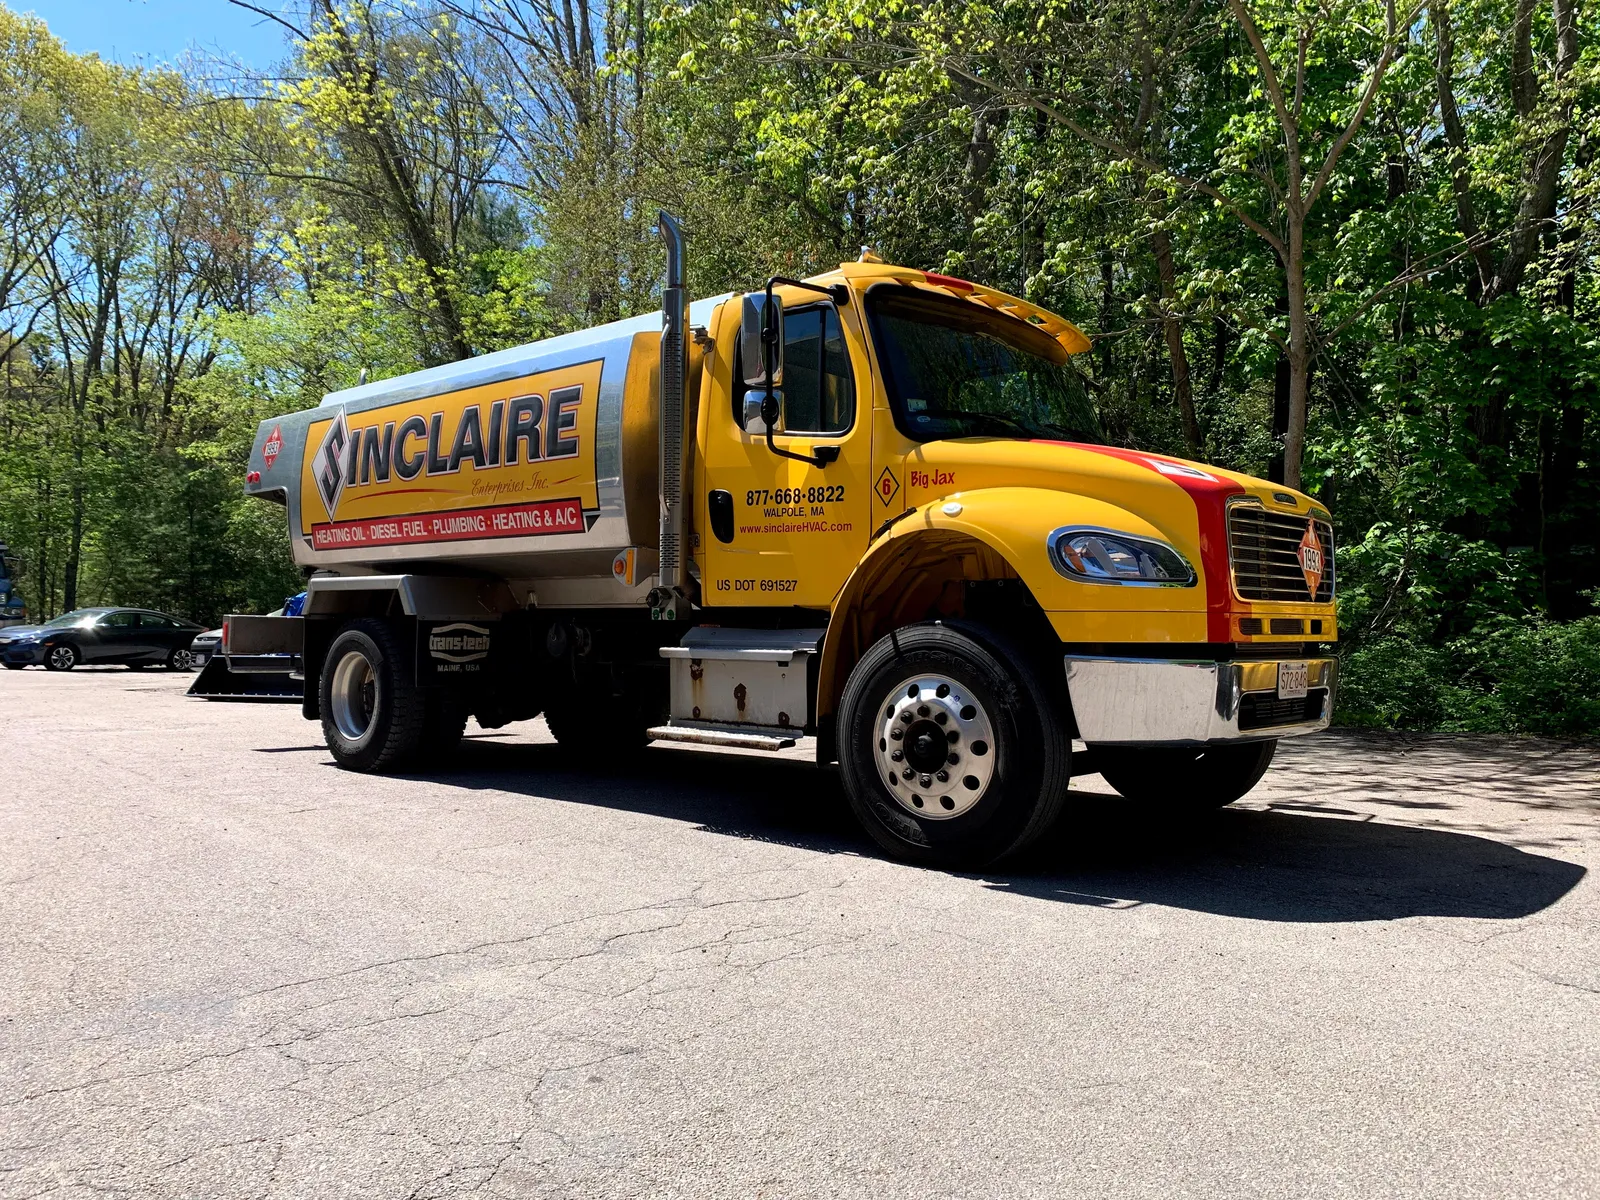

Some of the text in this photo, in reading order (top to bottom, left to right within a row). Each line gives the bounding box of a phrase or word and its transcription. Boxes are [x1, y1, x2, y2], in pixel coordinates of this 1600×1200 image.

[318, 383, 584, 506] SINCLAIRE
[471, 471, 549, 503] Enterprises Inc.
[881, 478, 892, 496] 6
[910, 469, 956, 489] Big Jax
[763, 506, 825, 518] WALPOLE, MA
[315, 506, 577, 544] HEATING OIL DIESEL FUEL PLUMBING HEATING & A/C
[739, 521, 853, 534] www.sinclaireHVAC.com
[1304, 548, 1320, 573] 1993
[716, 579, 798, 592] US DOT 691527
